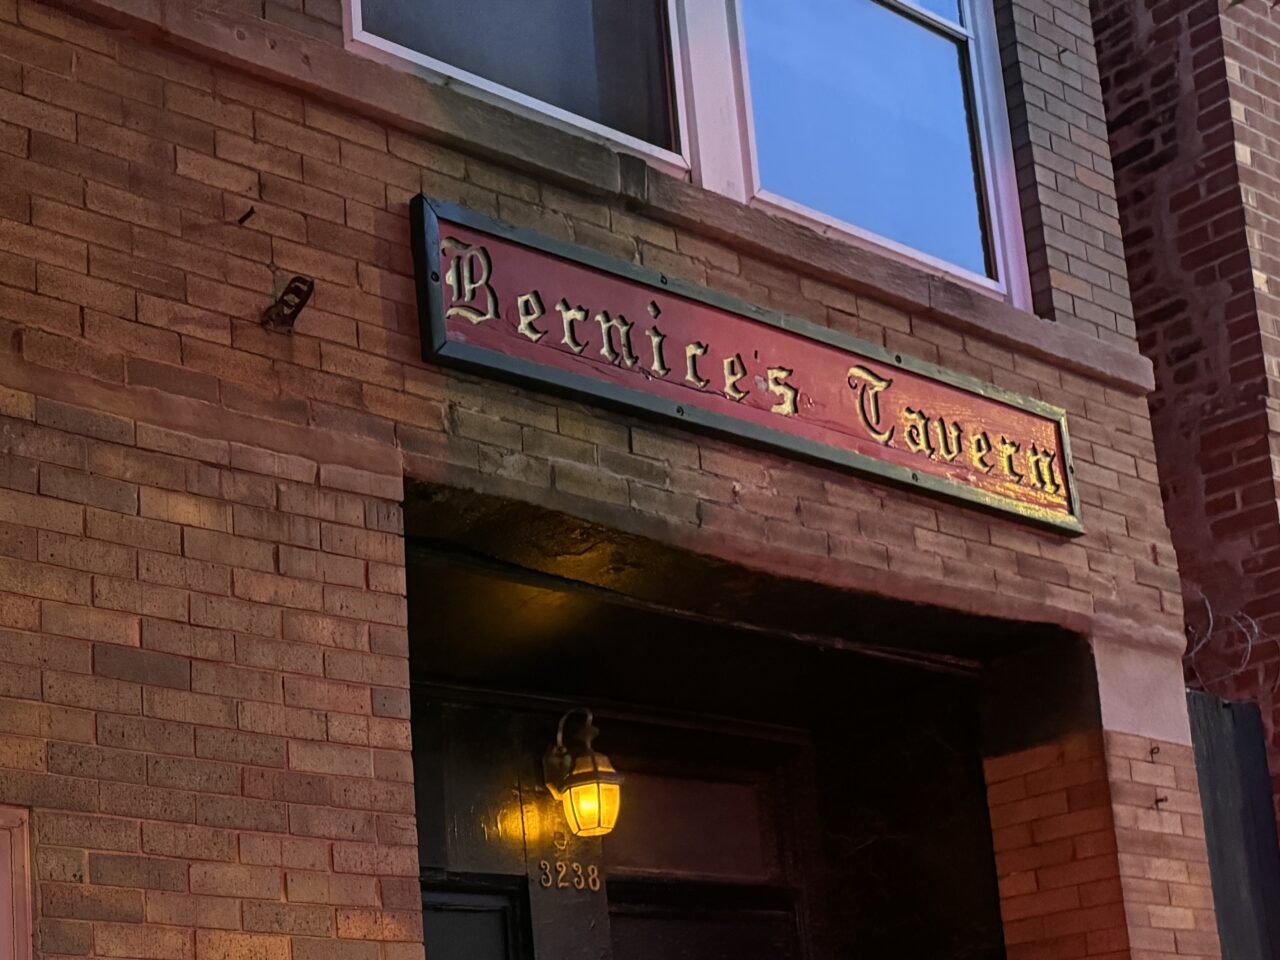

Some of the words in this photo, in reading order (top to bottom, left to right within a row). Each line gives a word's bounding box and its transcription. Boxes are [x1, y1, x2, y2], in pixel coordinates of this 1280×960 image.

[440, 236, 801, 417] Bernice's
[847, 364, 1060, 494] Tavern
[540, 860, 600, 891] 3238
